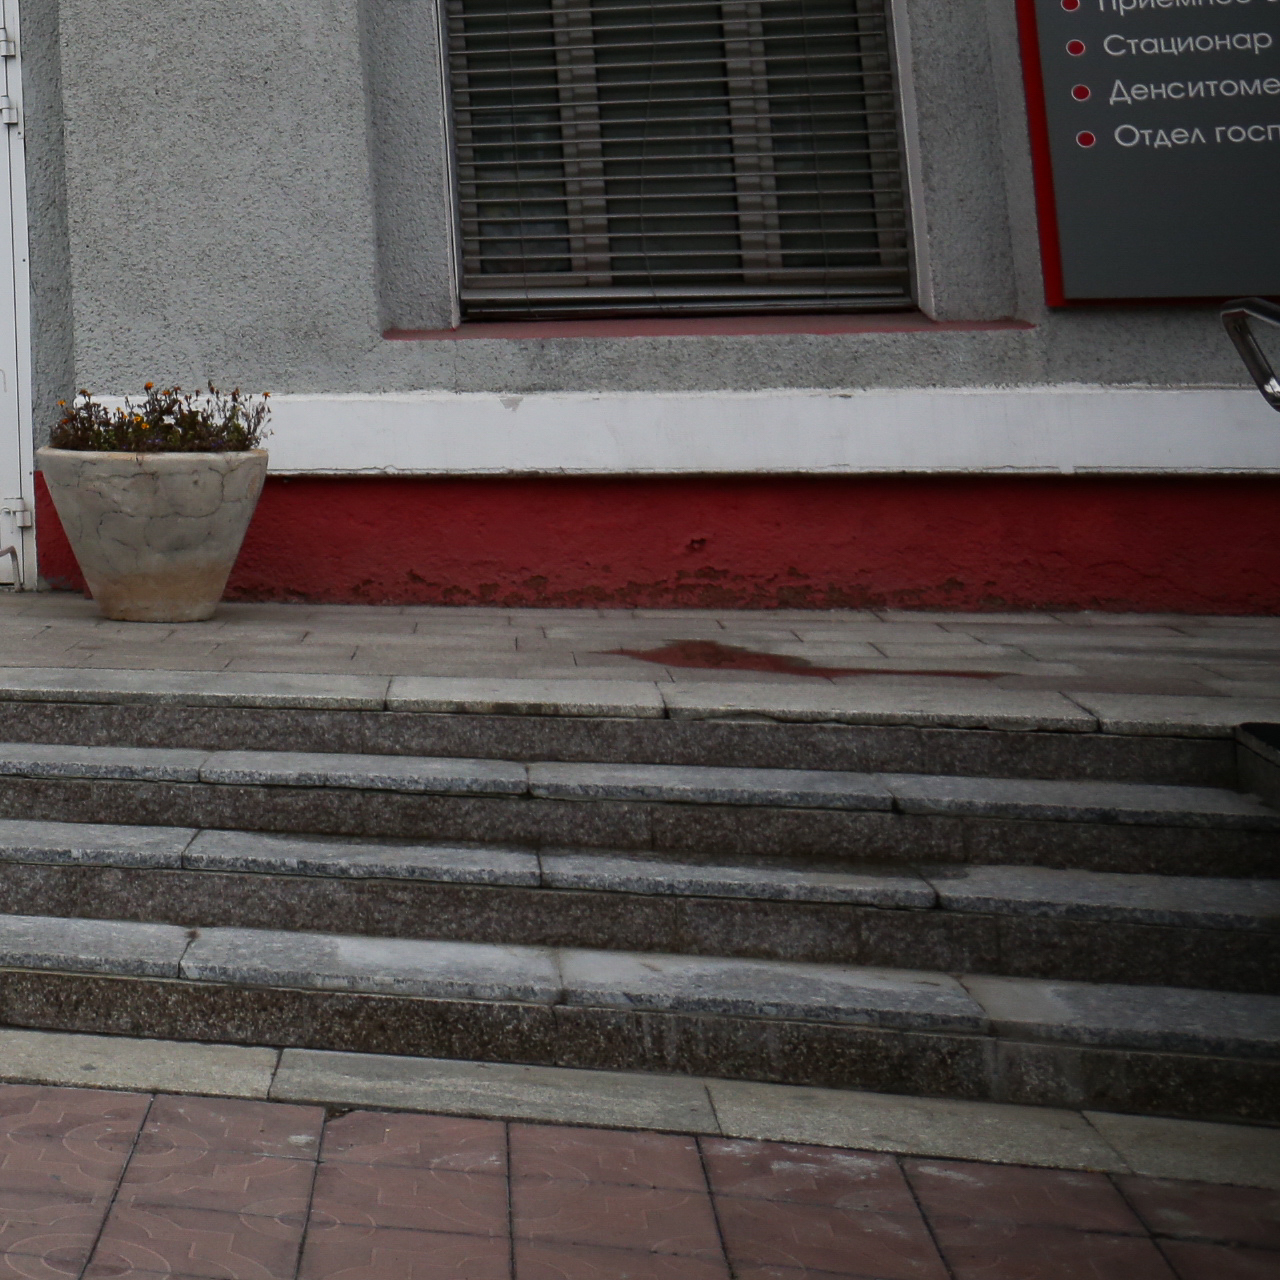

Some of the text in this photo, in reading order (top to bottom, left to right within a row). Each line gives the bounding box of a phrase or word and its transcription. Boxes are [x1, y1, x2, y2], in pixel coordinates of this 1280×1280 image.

[1103, 32, 1273, 57] Стационар
[1109, 77, 1280, 106] Денситоме
[1114, 124, 1206, 149] Отдел
